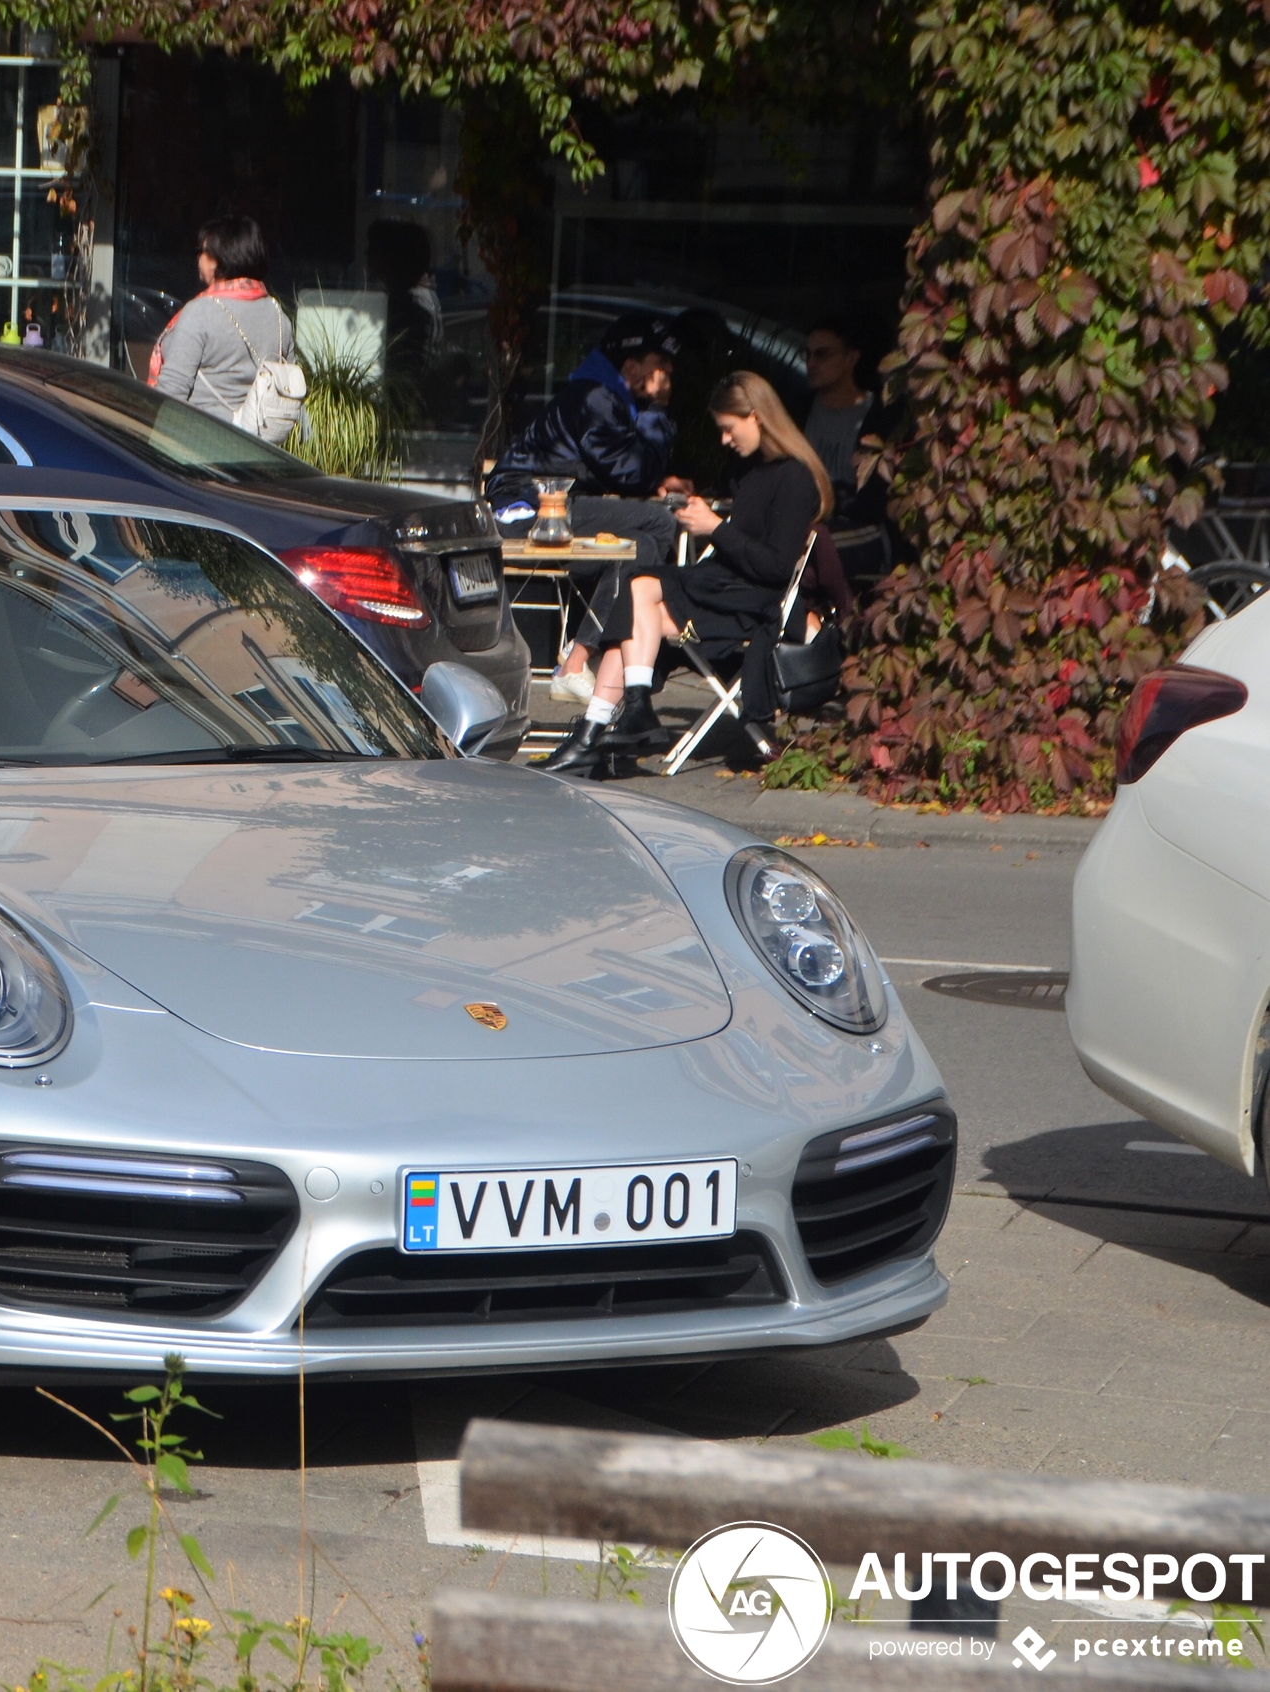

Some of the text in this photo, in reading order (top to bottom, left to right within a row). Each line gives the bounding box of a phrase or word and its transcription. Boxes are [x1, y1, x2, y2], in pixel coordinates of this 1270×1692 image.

[449, 1169, 720, 1239] VVM 001
[409, 1225, 435, 1242] LT
